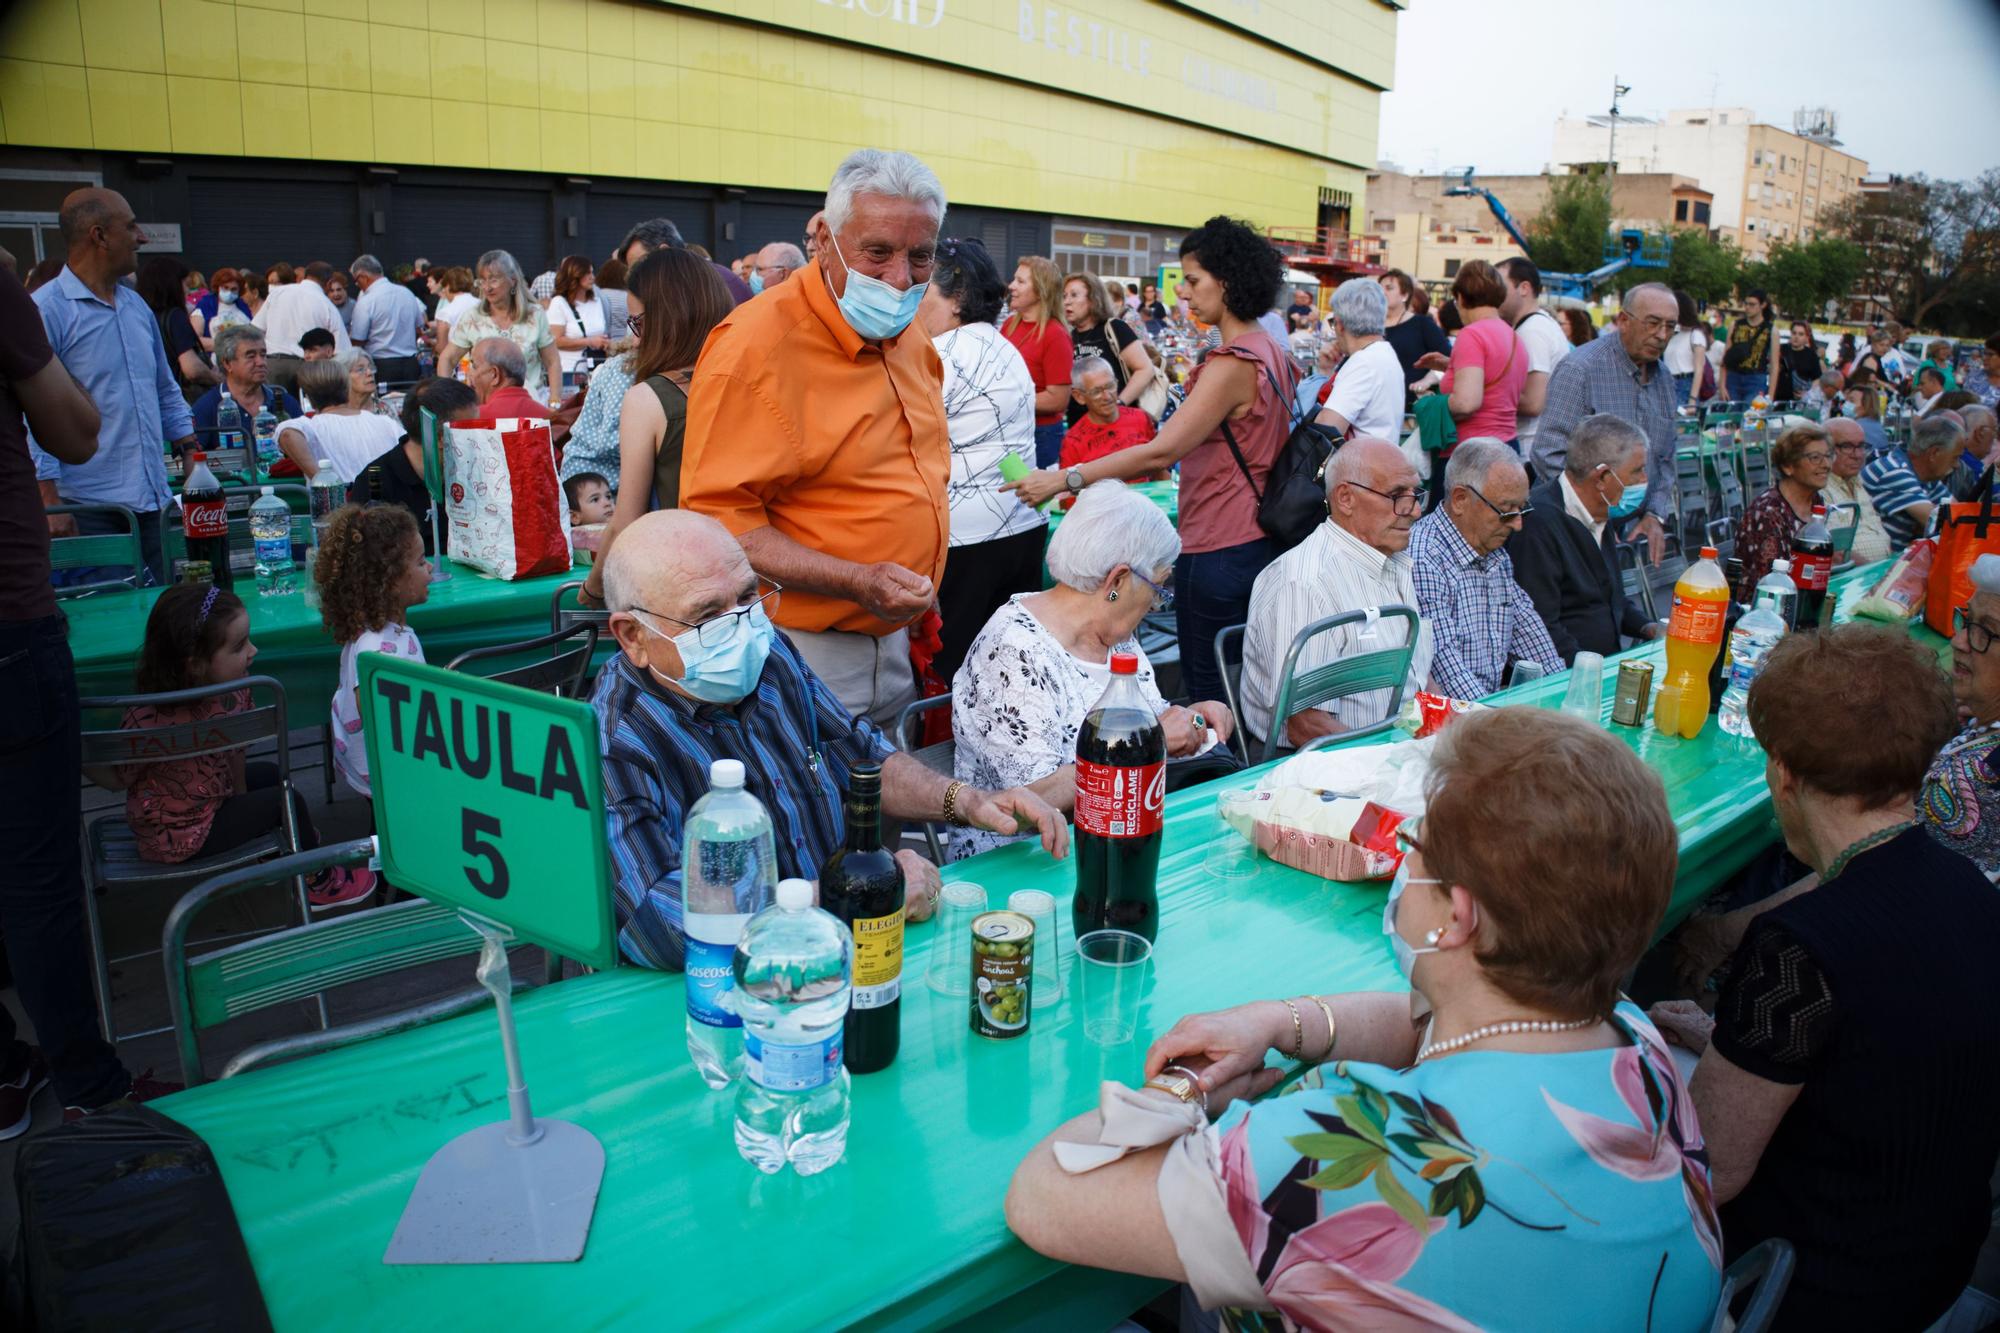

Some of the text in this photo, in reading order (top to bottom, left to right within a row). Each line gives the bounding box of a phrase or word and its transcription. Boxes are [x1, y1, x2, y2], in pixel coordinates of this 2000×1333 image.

[1018, 0, 1150, 77] BESTILE
[377, 678, 590, 811] TAULA
[1125, 769, 1138, 835] RECÍCLAME
[461, 806, 510, 900] 5
